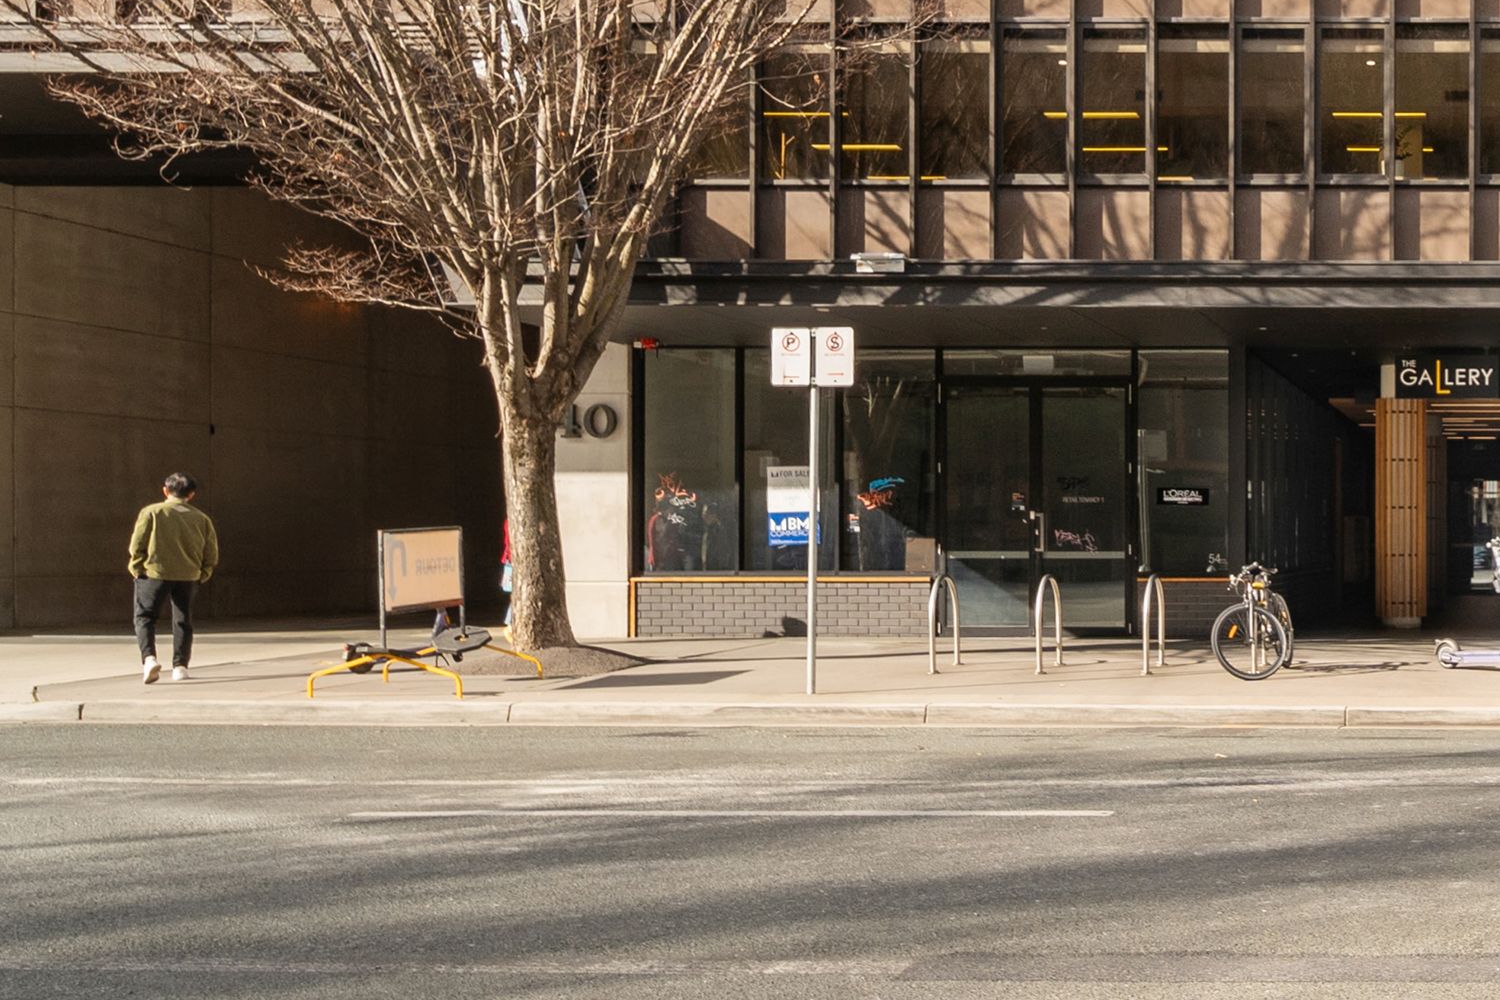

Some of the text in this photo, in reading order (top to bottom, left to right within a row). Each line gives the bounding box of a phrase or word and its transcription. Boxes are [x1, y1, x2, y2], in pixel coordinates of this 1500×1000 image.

[1401, 360, 1416, 368] THE
[1400, 360, 1494, 394] GALLERY
[780, 470, 792, 478] FOR
[1208, 553, 1221, 565] 54
